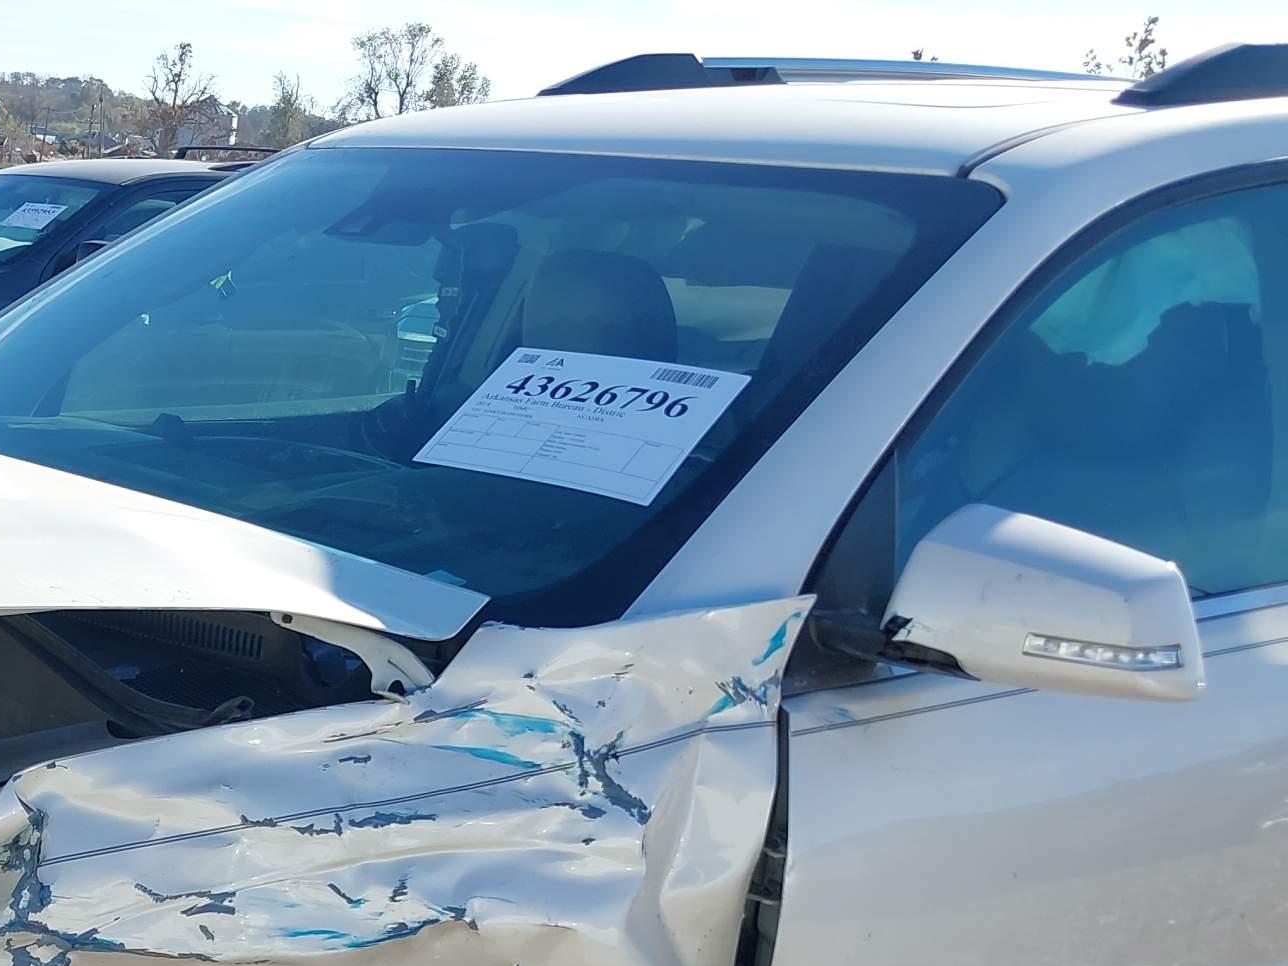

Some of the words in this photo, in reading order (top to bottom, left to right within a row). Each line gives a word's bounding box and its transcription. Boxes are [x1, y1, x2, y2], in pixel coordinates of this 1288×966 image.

[481, 392, 523, 404] Arkansas
[524, 398, 549, 407] Farm
[551, 400, 585, 412] Bureau
[505, 374, 698, 418] 43626796
